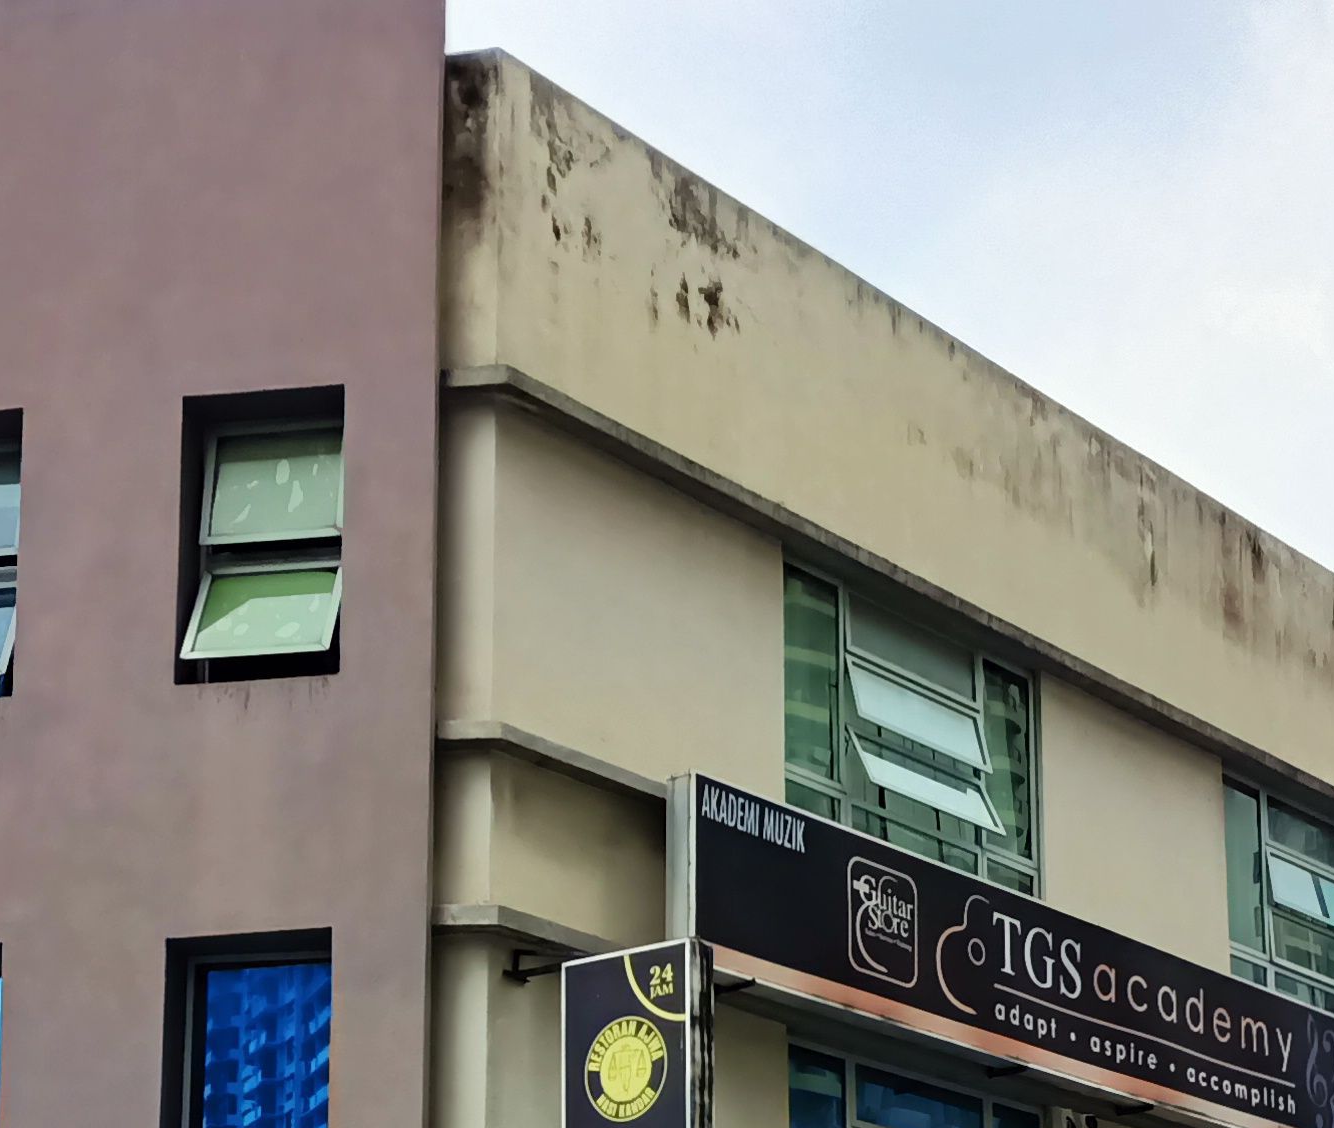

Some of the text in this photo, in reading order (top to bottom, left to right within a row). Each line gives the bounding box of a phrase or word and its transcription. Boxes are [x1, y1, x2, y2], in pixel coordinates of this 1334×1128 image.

[701, 784, 805, 853] AKADEMI MUZIK
[853, 875, 913, 920] Guitar
[869, 904, 909, 937] Store
[649, 963, 674, 985] 24
[650, 983, 674, 999] JAM
[993, 911, 1292, 1073] TGS academy
[588, 1020, 664, 1072] RESTORAN AJWA
[995, 1003, 1295, 1115] adapt aspire accomplish
